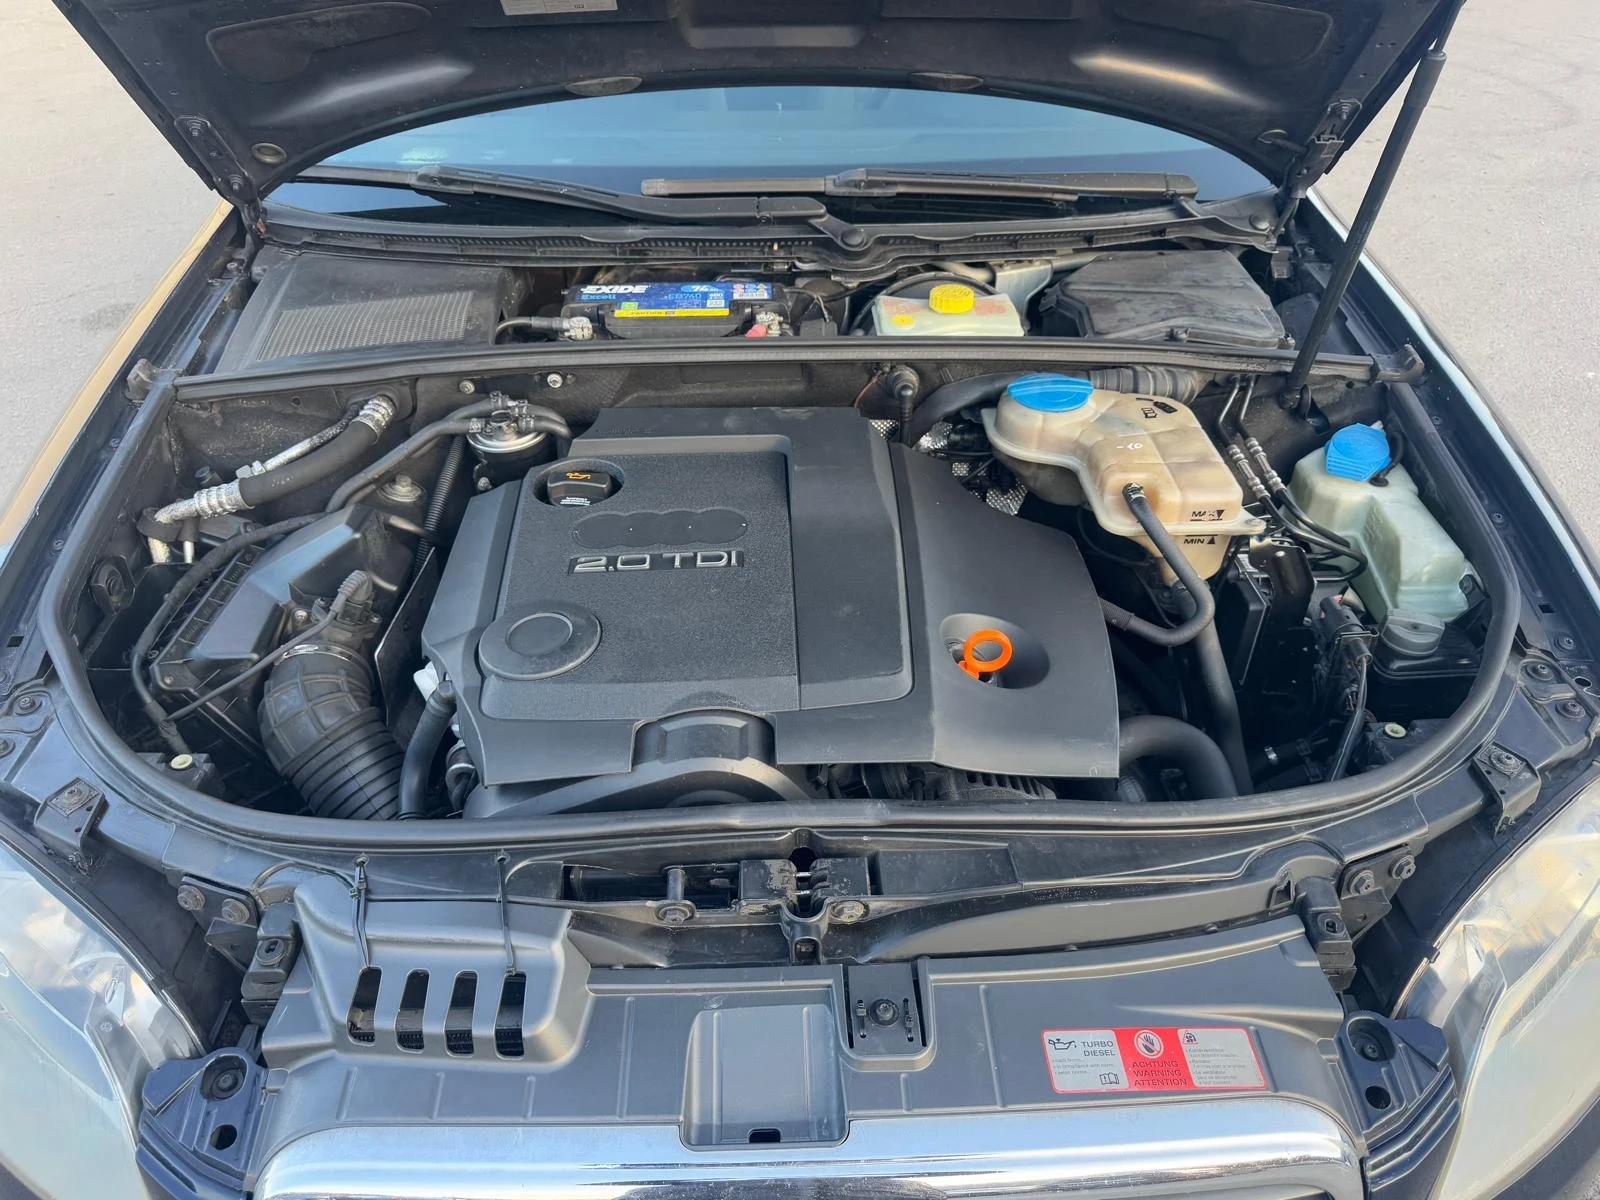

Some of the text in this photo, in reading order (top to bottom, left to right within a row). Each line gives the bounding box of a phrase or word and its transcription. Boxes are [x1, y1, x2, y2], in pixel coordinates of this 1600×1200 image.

[580, 285, 651, 294] EXIDE
[573, 550, 738, 574] 2.0 TDI
[1081, 1040, 1114, 1048] TURBO
[1084, 1049, 1116, 1057] DIESEL
[1132, 1060, 1178, 1068] ACHTUNG
[1133, 1069, 1182, 1077] WARNING
[1134, 1078, 1187, 1087] ATTENTION
